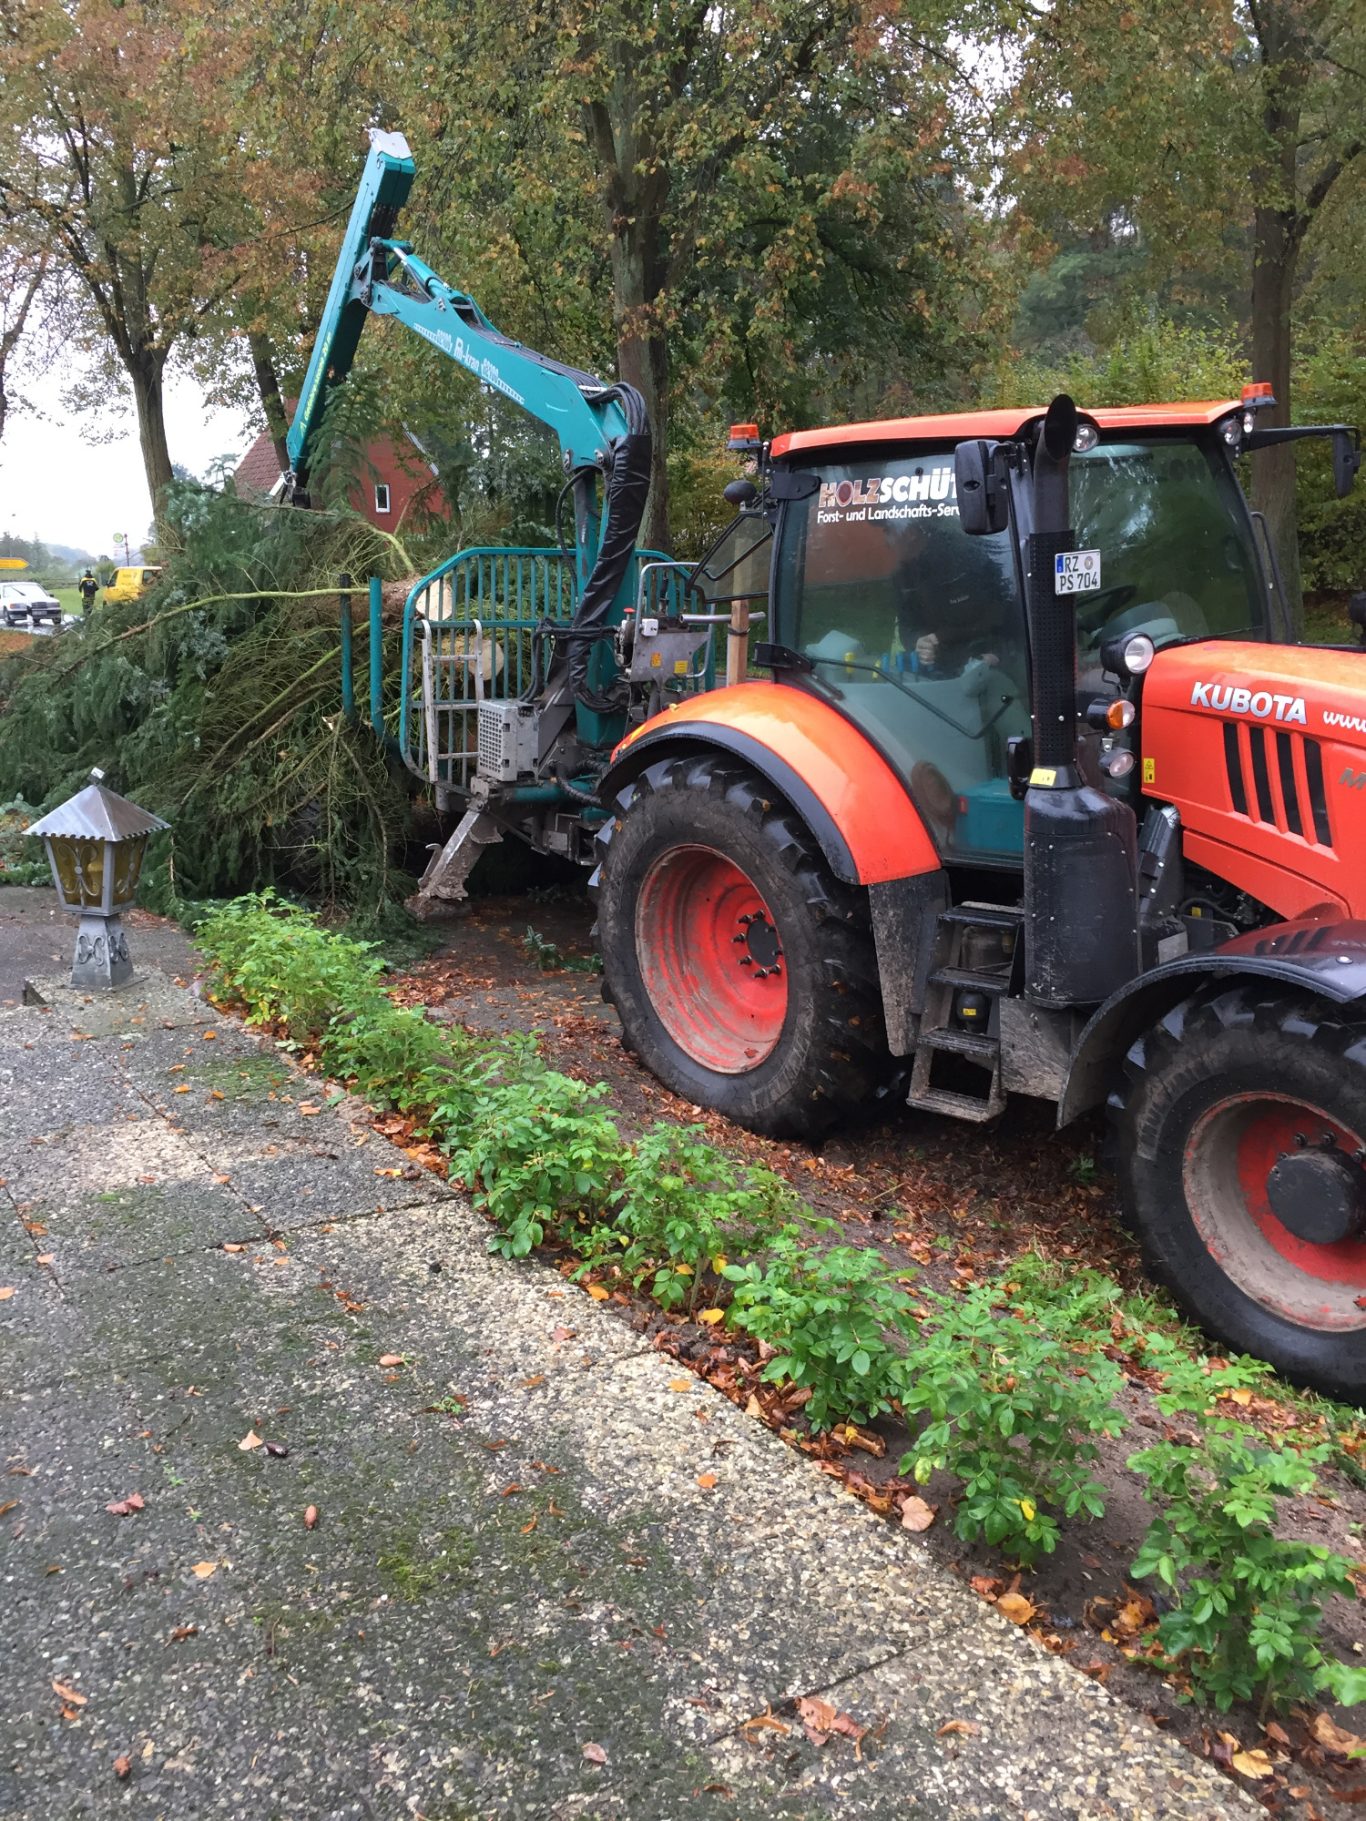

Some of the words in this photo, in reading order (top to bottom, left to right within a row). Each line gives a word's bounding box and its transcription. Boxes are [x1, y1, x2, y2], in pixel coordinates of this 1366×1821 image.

[817, 509, 844, 524] Forst-
[846, 507, 866, 521] und
[1065, 555, 1079, 573] RZ
[1060, 573, 1074, 591] PS
[1077, 571, 1098, 589] 704
[1191, 681, 1307, 725] KUBOTA
